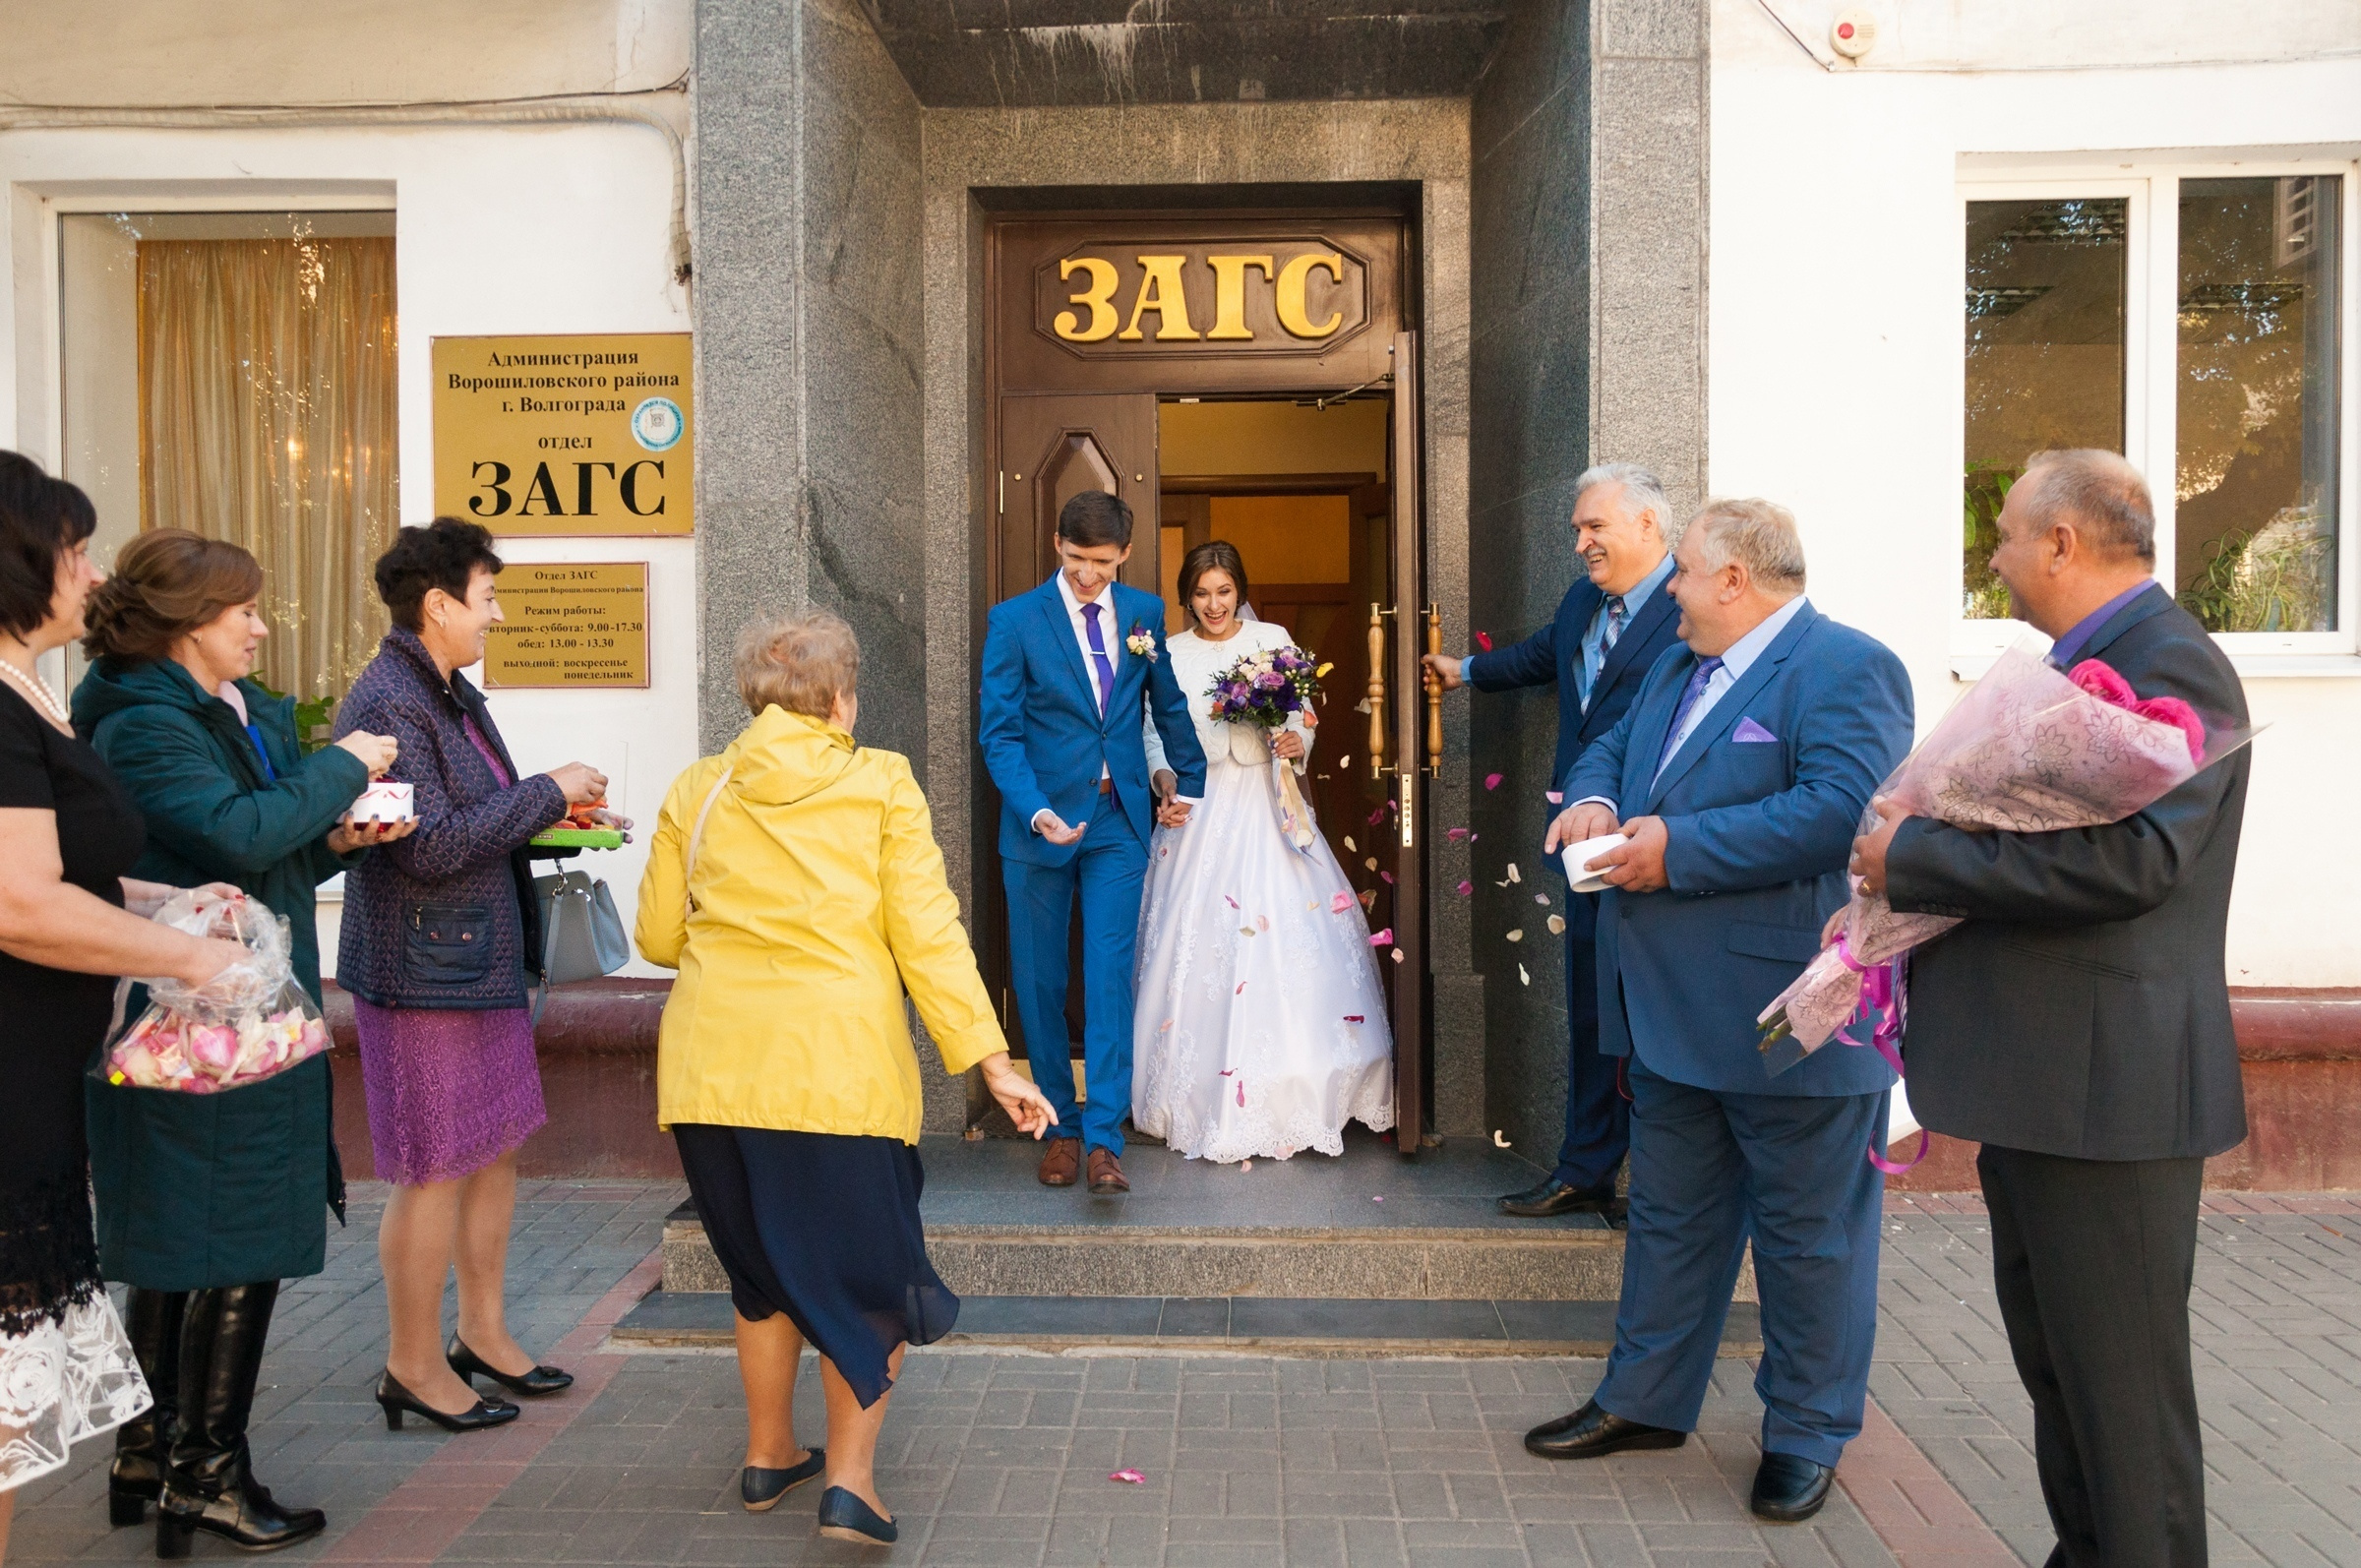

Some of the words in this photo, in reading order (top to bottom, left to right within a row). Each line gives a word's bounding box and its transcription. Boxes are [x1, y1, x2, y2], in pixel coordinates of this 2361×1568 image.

[1054, 253, 1343, 341] ЗАГС
[487, 351, 638, 370] Администрация
[449, 373, 607, 392] Ворошиловского
[614, 371, 680, 391] района
[502, 399, 514, 412] г.
[519, 396, 626, 415] Волгограда
[538, 437, 592, 450] отдел
[468, 459, 665, 517] ЗАГС
[534, 571, 566, 580] Отдел
[569, 570, 598, 580] ЗАГС
[494, 586, 549, 595] министрации
[550, 585, 616, 596] Ворошиловского
[524, 606, 561, 615] Режим
[563, 605, 606, 617] работы:
[517, 638, 545, 649] обед:
[550, 638, 577, 648] 13.00
[587, 637, 615, 648] 13.30
[503, 658, 560, 668] выходной:
[563, 659, 629, 670] воскресенье
[564, 671, 635, 680] понедельник
